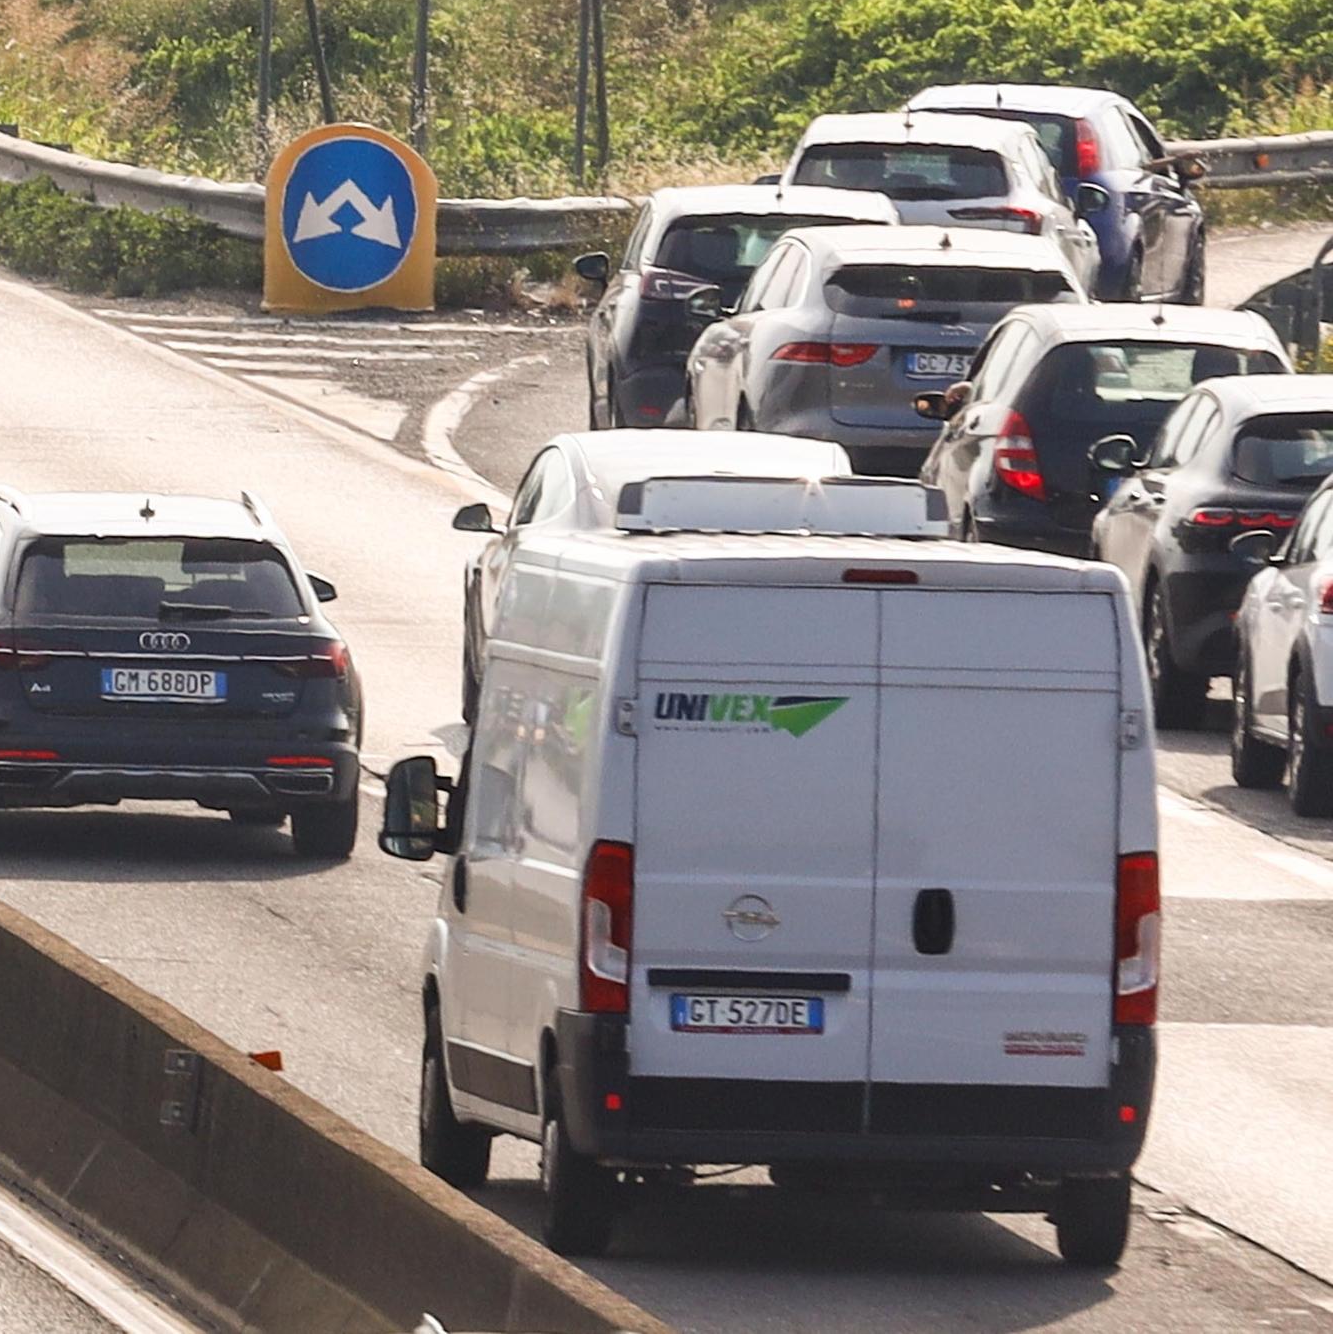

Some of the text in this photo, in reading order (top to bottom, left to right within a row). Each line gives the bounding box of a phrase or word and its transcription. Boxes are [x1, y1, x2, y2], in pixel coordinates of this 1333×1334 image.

[114, 671, 212, 693] GM 688DP
[654, 693, 771, 722] UNIVEX
[690, 999, 805, 1025] GT 527DE
